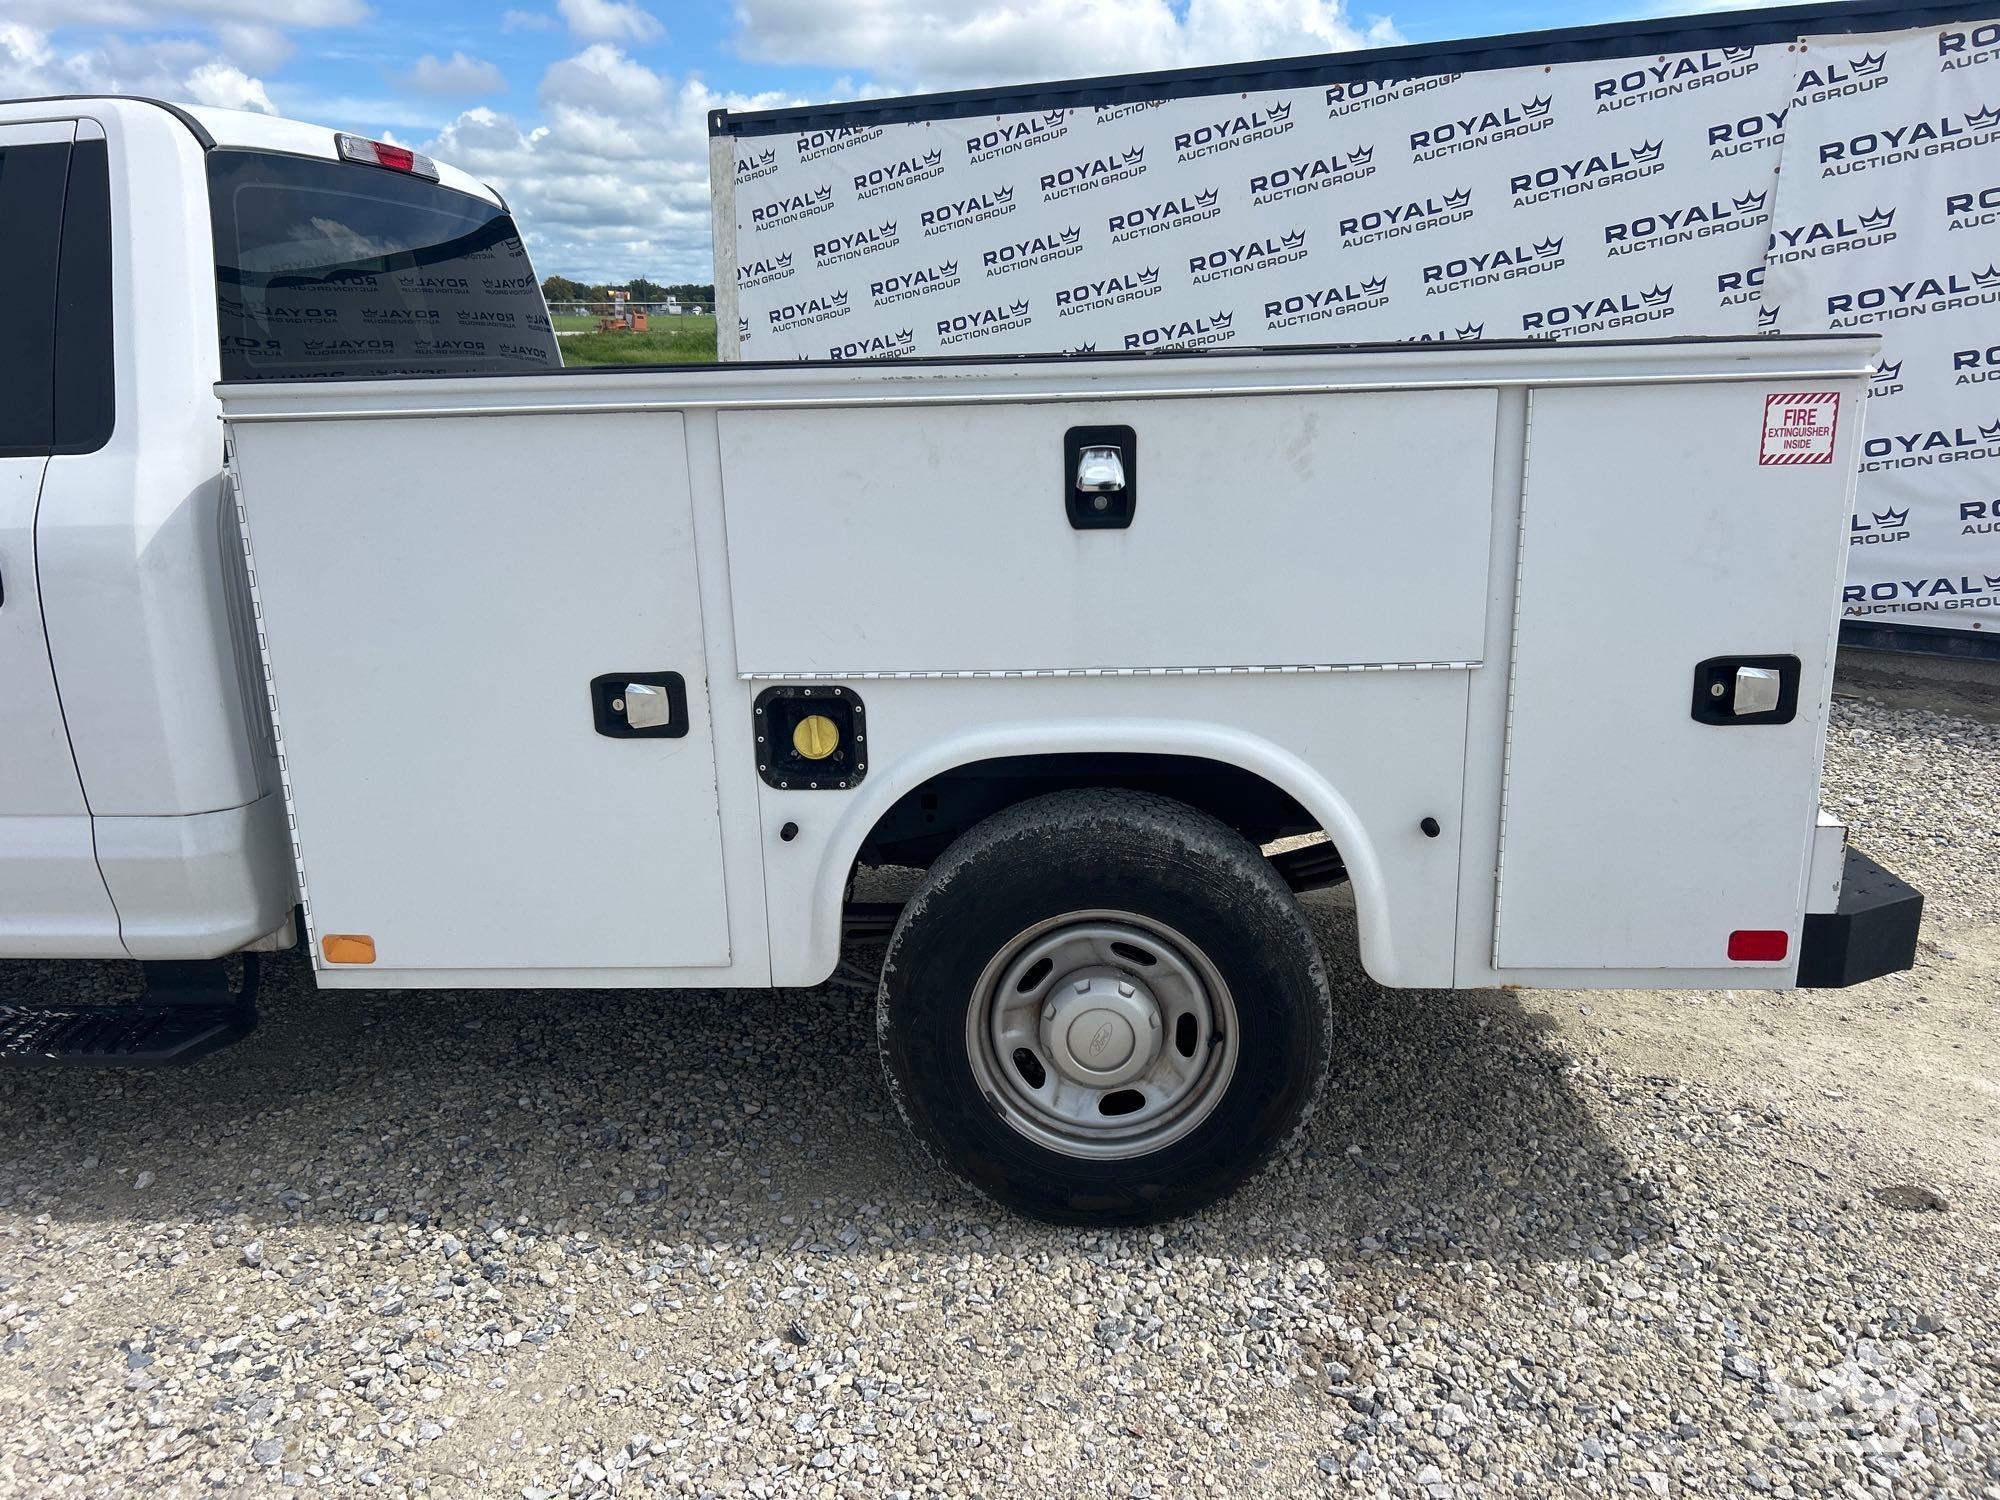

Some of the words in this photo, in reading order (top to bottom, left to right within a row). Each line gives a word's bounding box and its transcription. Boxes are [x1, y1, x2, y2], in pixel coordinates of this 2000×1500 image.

[1595, 52, 1721, 99] ROYAL
[1941, 48, 2000, 72] AUCT
[1597, 83, 1682, 114] AUCTION
[1688, 62, 1758, 90] GROUP
[1812, 76, 1888, 103] GROUP
[1329, 91, 1399, 119] AUCTION
[967, 119, 1044, 153] ROYAL
[1175, 112, 1266, 151] ROYAL
[1411, 108, 1521, 150] ROYAL
[1413, 135, 1487, 164] AUCTION
[1492, 118, 1554, 142] GROUP
[1709, 106, 1790, 146] ROY
[1820, 117, 1962, 163] ROYAL
[801, 142, 844, 163] AUCTION
[847, 129, 883, 147] GROUP
[970, 142, 1022, 165] AUCTION
[1025, 128, 1067, 148] GROUP
[1178, 137, 1239, 164] AUCTION
[1243, 122, 1293, 144] GROUP
[1711, 134, 1785, 160] AUCTIO
[1822, 149, 1919, 178] AUCTION
[1924, 131, 2000, 156] GROUP
[745, 166, 778, 181] GROUP
[854, 158, 923, 190] ROYAL
[858, 179, 904, 200] AUCTION
[906, 167, 944, 185] GROUP
[1041, 156, 1122, 191] ROYAL
[1044, 180, 1099, 202] AUCTION
[1101, 166, 1146, 185] GROUP
[1251, 156, 1347, 194] ROYAL
[1253, 182, 1318, 206] AUCTION
[1322, 166, 1376, 188] GROUP
[1511, 152, 1629, 194] ROYAL
[1513, 180, 1593, 208] AUCTION
[1598, 162, 1664, 187] GROUP
[752, 193, 815, 222] ROYAL
[756, 214, 797, 232] AUCTION
[800, 202, 834, 219] GROUP
[921, 195, 994, 226] ROYAL
[924, 217, 973, 237] AUCTION
[976, 204, 1016, 222] GROUP
[1109, 197, 1195, 232] ROYAL
[1340, 199, 1442, 236] ROYAL
[1605, 201, 1731, 243] ROYAL
[1112, 222, 1170, 244] AUCTION
[1172, 208, 1221, 227] GROUP
[1342, 225, 1412, 248] AUCTION
[1416, 210, 1473, 231] GROUP
[1608, 230, 1692, 257] AUCTION
[1698, 214, 1768, 238] GROUP
[1768, 219, 1857, 251] YAL
[814, 228, 880, 258] ROYAL
[817, 249, 861, 268] AUCTION
[863, 238, 899, 255] GROUP
[983, 235, 1060, 266] ROYAL
[1190, 239, 1280, 273] ROYAL
[1768, 248, 1816, 265] TION
[1821, 232, 1896, 256] GROUP
[737, 259, 776, 280] YAL
[986, 257, 1038, 277] AUCTION
[1040, 246, 1083, 263] GROUP
[1193, 264, 1253, 285] AUCTION
[1258, 250, 1307, 269] GROUP
[1423, 247, 1532, 283] ROYAL
[1426, 272, 1499, 296] AUCTION
[1504, 259, 1565, 280] GROUP
[738, 279, 760, 290] TION
[762, 269, 795, 284] GROUP
[871, 268, 940, 297] ROYAL
[874, 288, 920, 307] AUCTION
[923, 278, 960, 294] GROUP
[1056, 275, 1137, 306] ROYAL
[1828, 274, 1970, 314] ROYAL
[769, 297, 831, 323] ROYAL
[1059, 298, 1114, 317] AUCTION
[1117, 286, 1161, 303] GROUP
[1265, 285, 1360, 318] ROYAL
[1268, 309, 1332, 330] AUCTION
[1336, 296, 1389, 315] GROUP
[1523, 295, 1639, 330] ROYAL
[1608, 307, 1674, 328] GROUP
[1829, 304, 1926, 329] AUCTION
[1932, 292, 2000, 312] GROU
[772, 317, 814, 333] AUCTION
[816, 307, 850, 322] GROUP
[937, 307, 1010, 335] ROYAL
[940, 328, 989, 345] AUCTION
[992, 317, 1032, 333] GROUP
[1124, 319, 1210, 349] ROYAL
[830, 335, 896, 360] ROYAL
[1188, 331, 1235, 348] GROUP
[1768, 427, 1829, 437] EXTINGUISHER
[1784, 409, 1817, 426] FIRE
[1784, 440, 1811, 449] INSIDE
[1864, 428, 1977, 457] OYAL
[1858, 455, 1933, 473] CTION
[1938, 447, 2000, 463] GROU
[1850, 532, 1910, 546] ROUP
[1843, 577, 1982, 602] ROYAL
[1844, 601, 1939, 616] AUCTION
